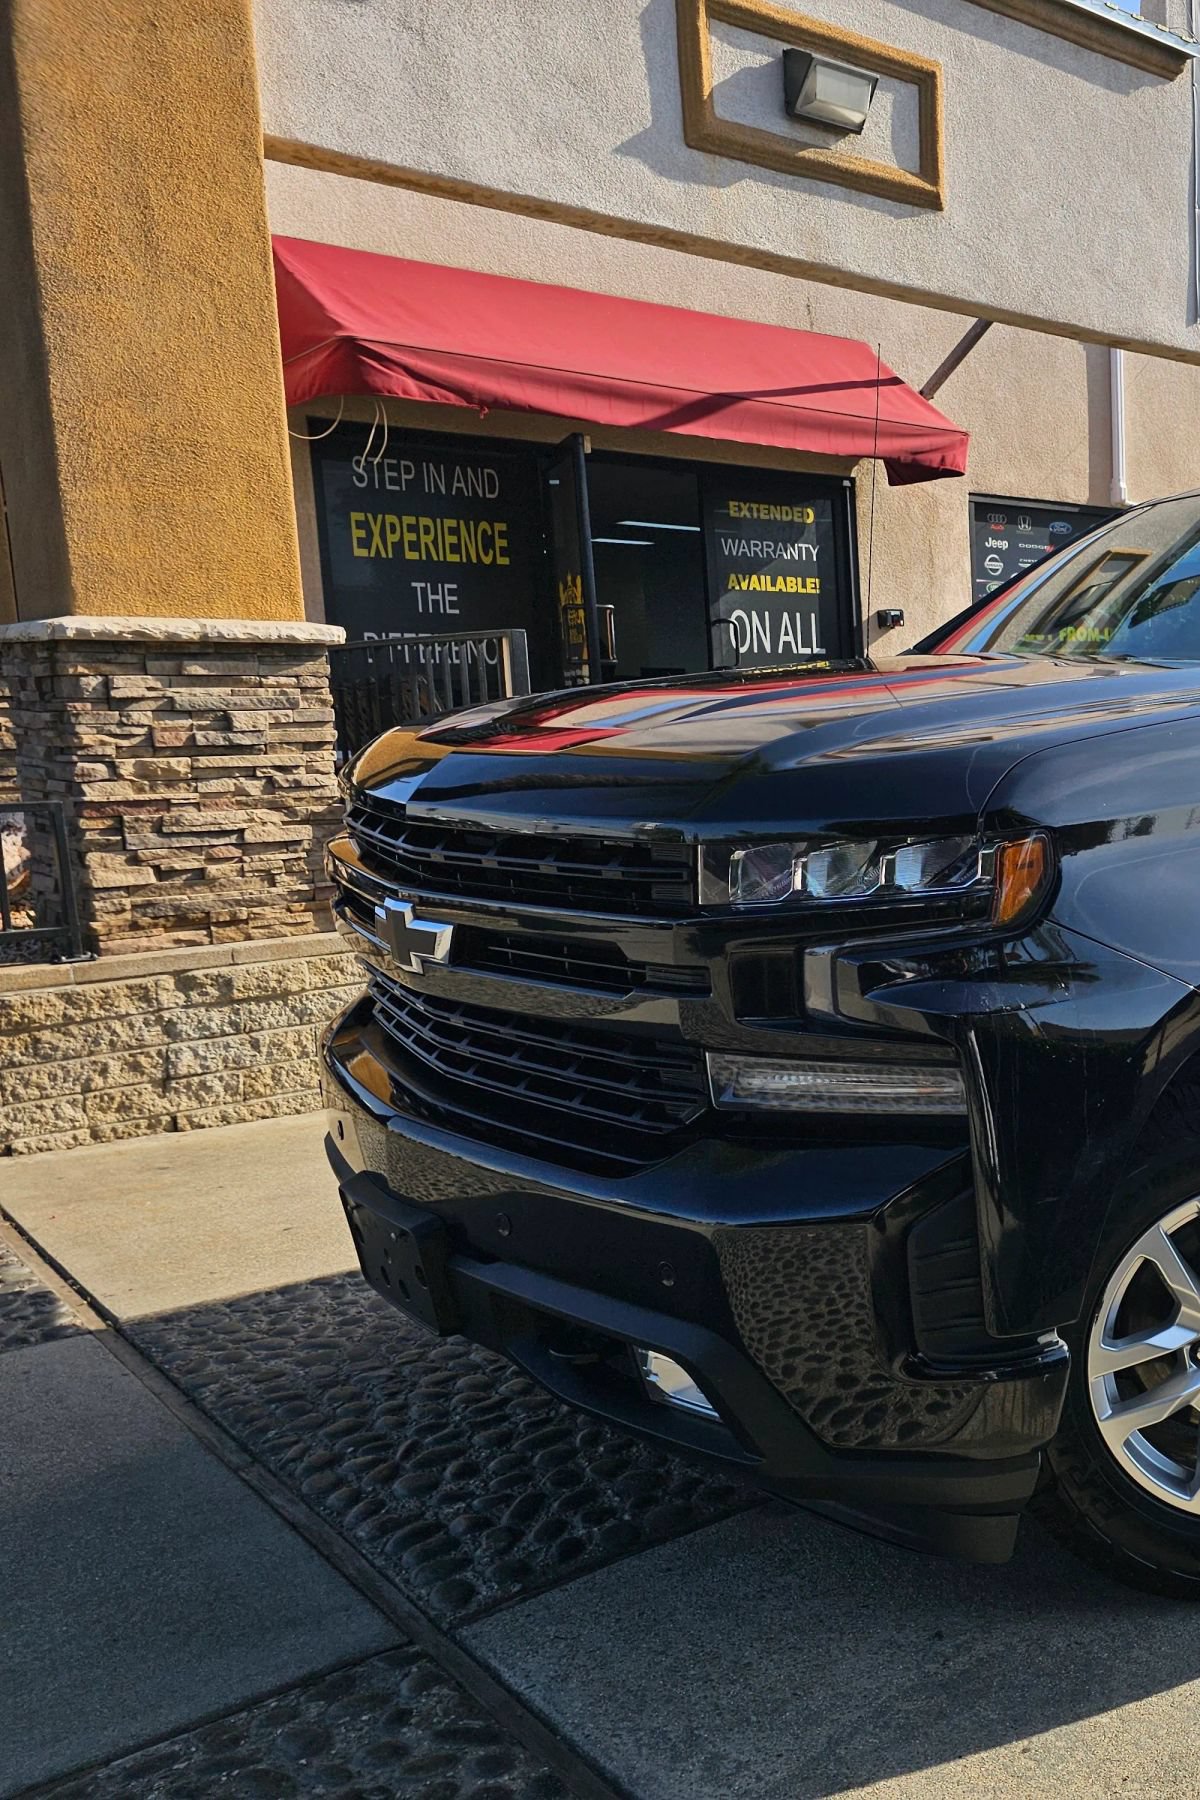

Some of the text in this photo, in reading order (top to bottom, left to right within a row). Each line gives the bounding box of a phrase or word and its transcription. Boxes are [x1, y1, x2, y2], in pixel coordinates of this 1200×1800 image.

[352, 455, 500, 499] STEP IN AND
[728, 500, 815, 524] EXTENDED
[350, 511, 511, 565] EXPERIENCE
[721, 537, 820, 562] WARRANTY
[985, 537, 1009, 551] Jeep
[410, 581, 460, 614] THE
[727, 573, 820, 594] AVAILABLE!
[729, 609, 826, 654] ON ALL
